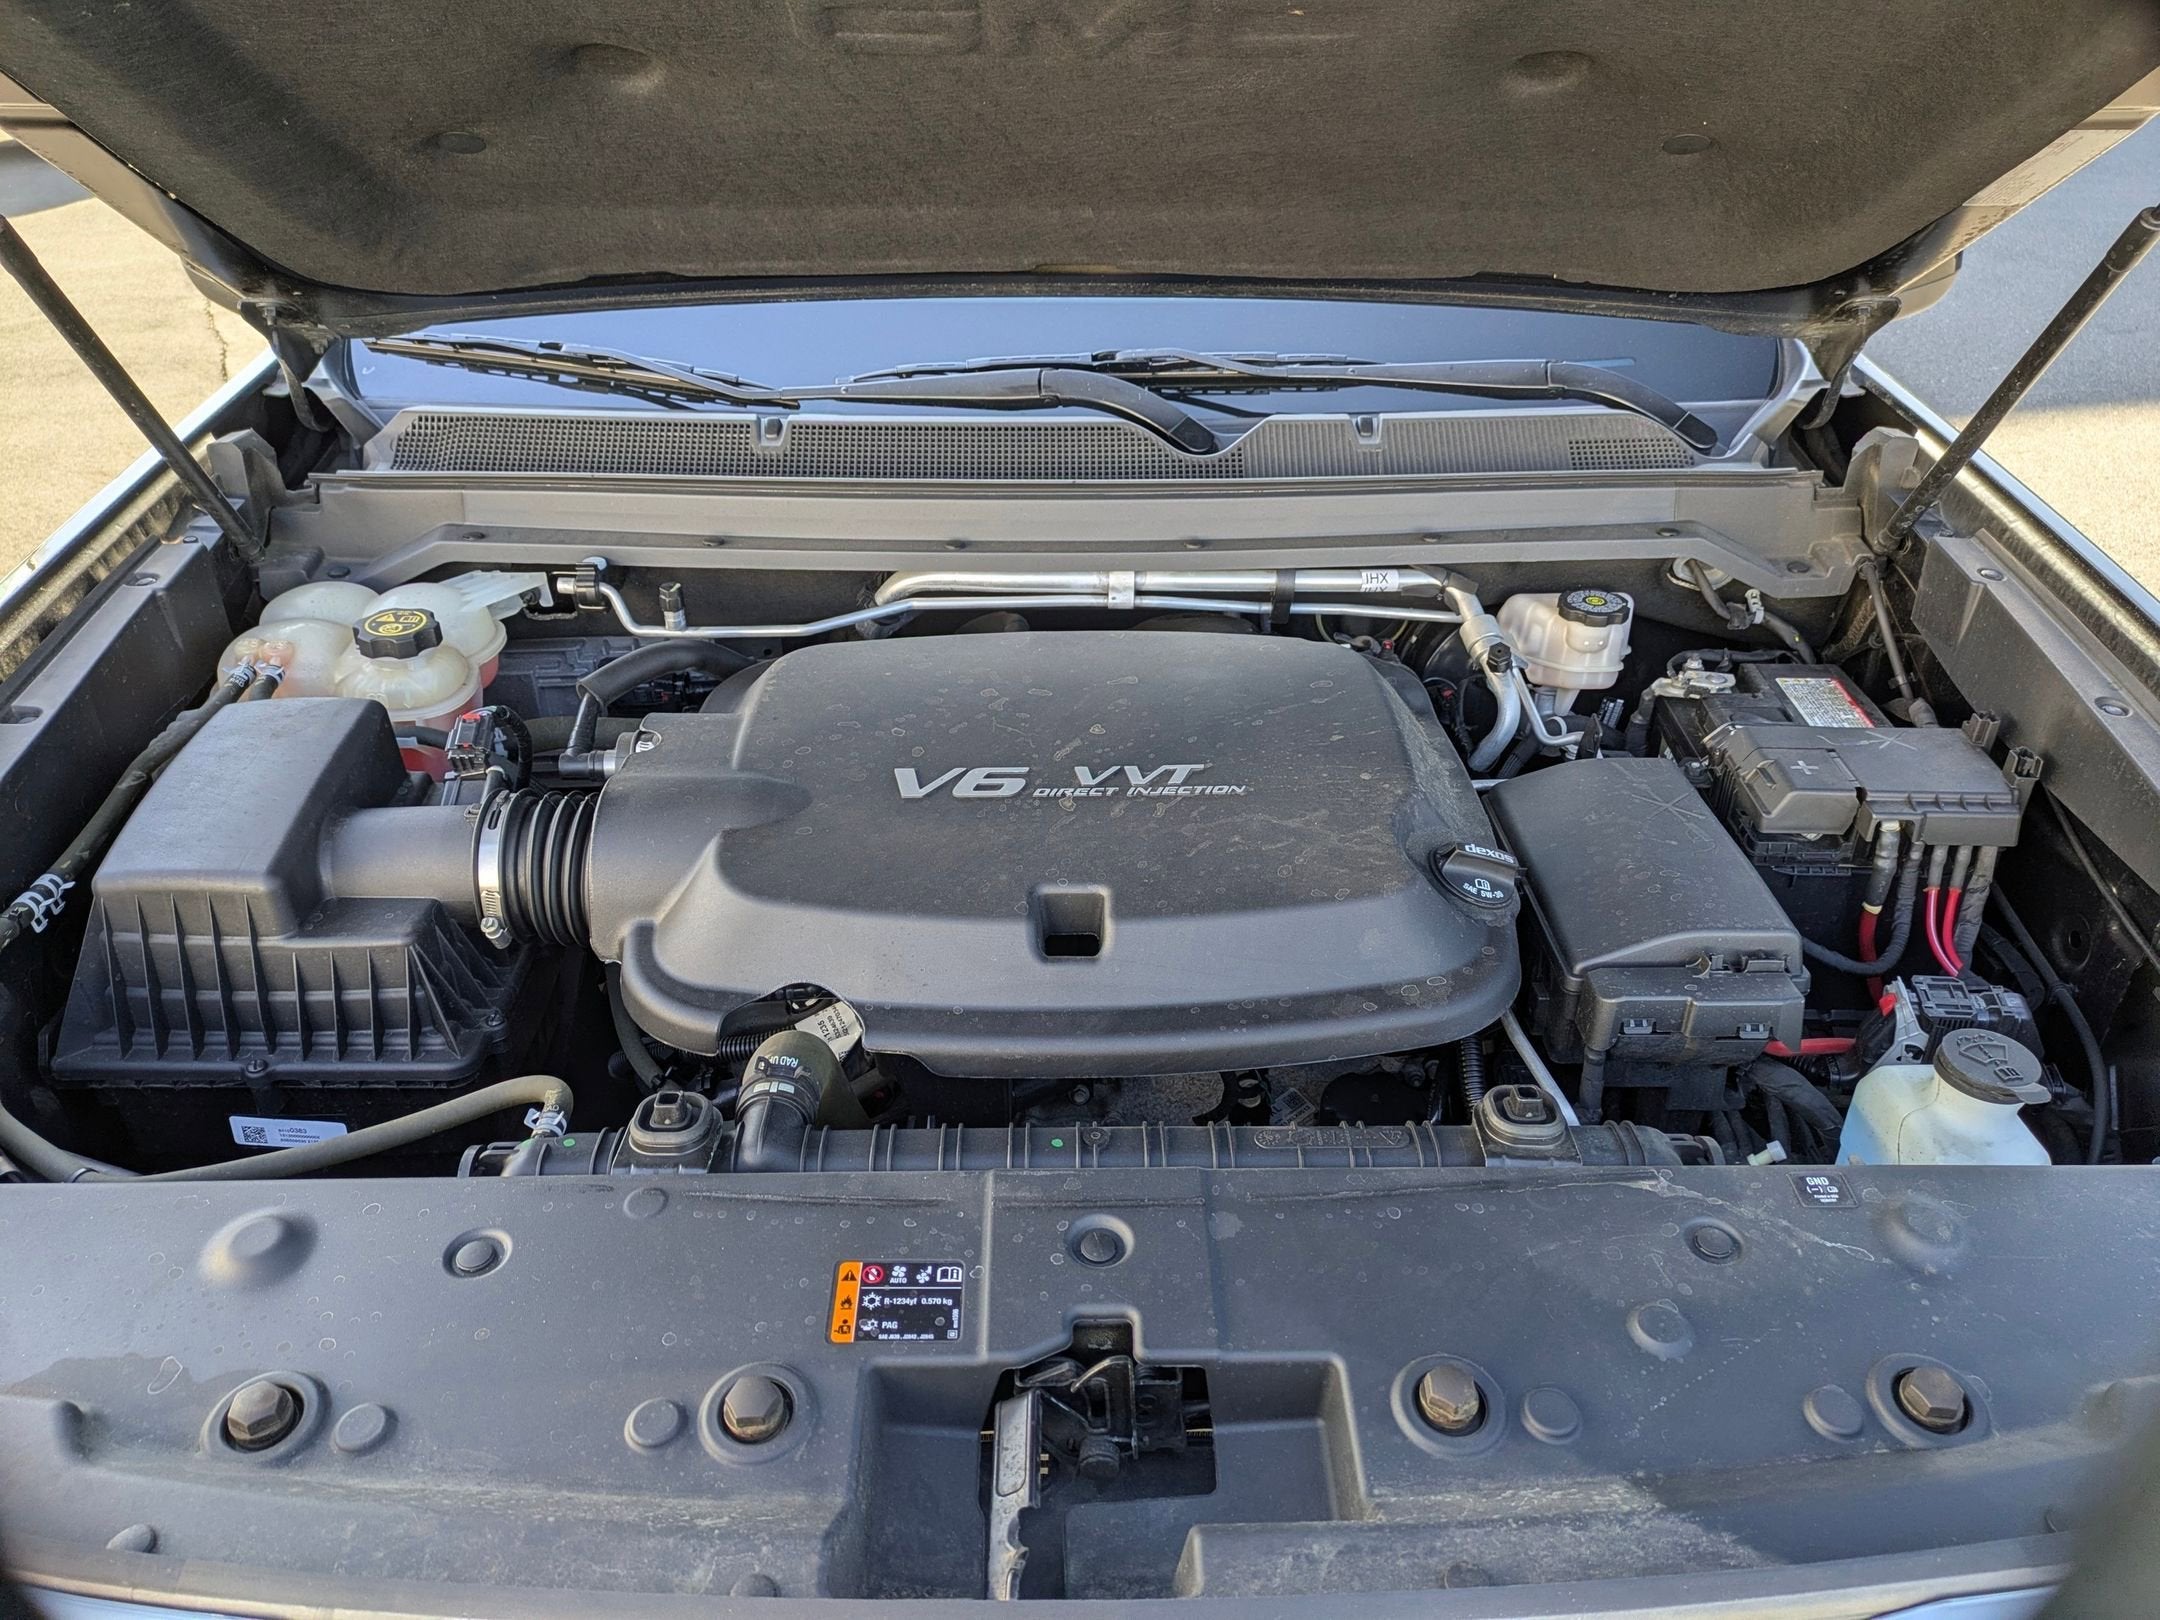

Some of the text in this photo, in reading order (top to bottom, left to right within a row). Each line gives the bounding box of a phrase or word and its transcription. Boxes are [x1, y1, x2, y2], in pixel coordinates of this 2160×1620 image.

[1074, 763, 1205, 786] VVT
[894, 767, 1030, 799] V6
[1032, 785, 1247, 797] DIRECT INJECTION
[1464, 843, 1514, 864] dexos
[1462, 882, 1478, 895] SAE
[779, 1056, 799, 1068] RAD
[1806, 1177, 1830, 1186] GND
[883, 1297, 953, 1306] R-1234yf 0.570 kg
[881, 1321, 899, 1329] PAG
